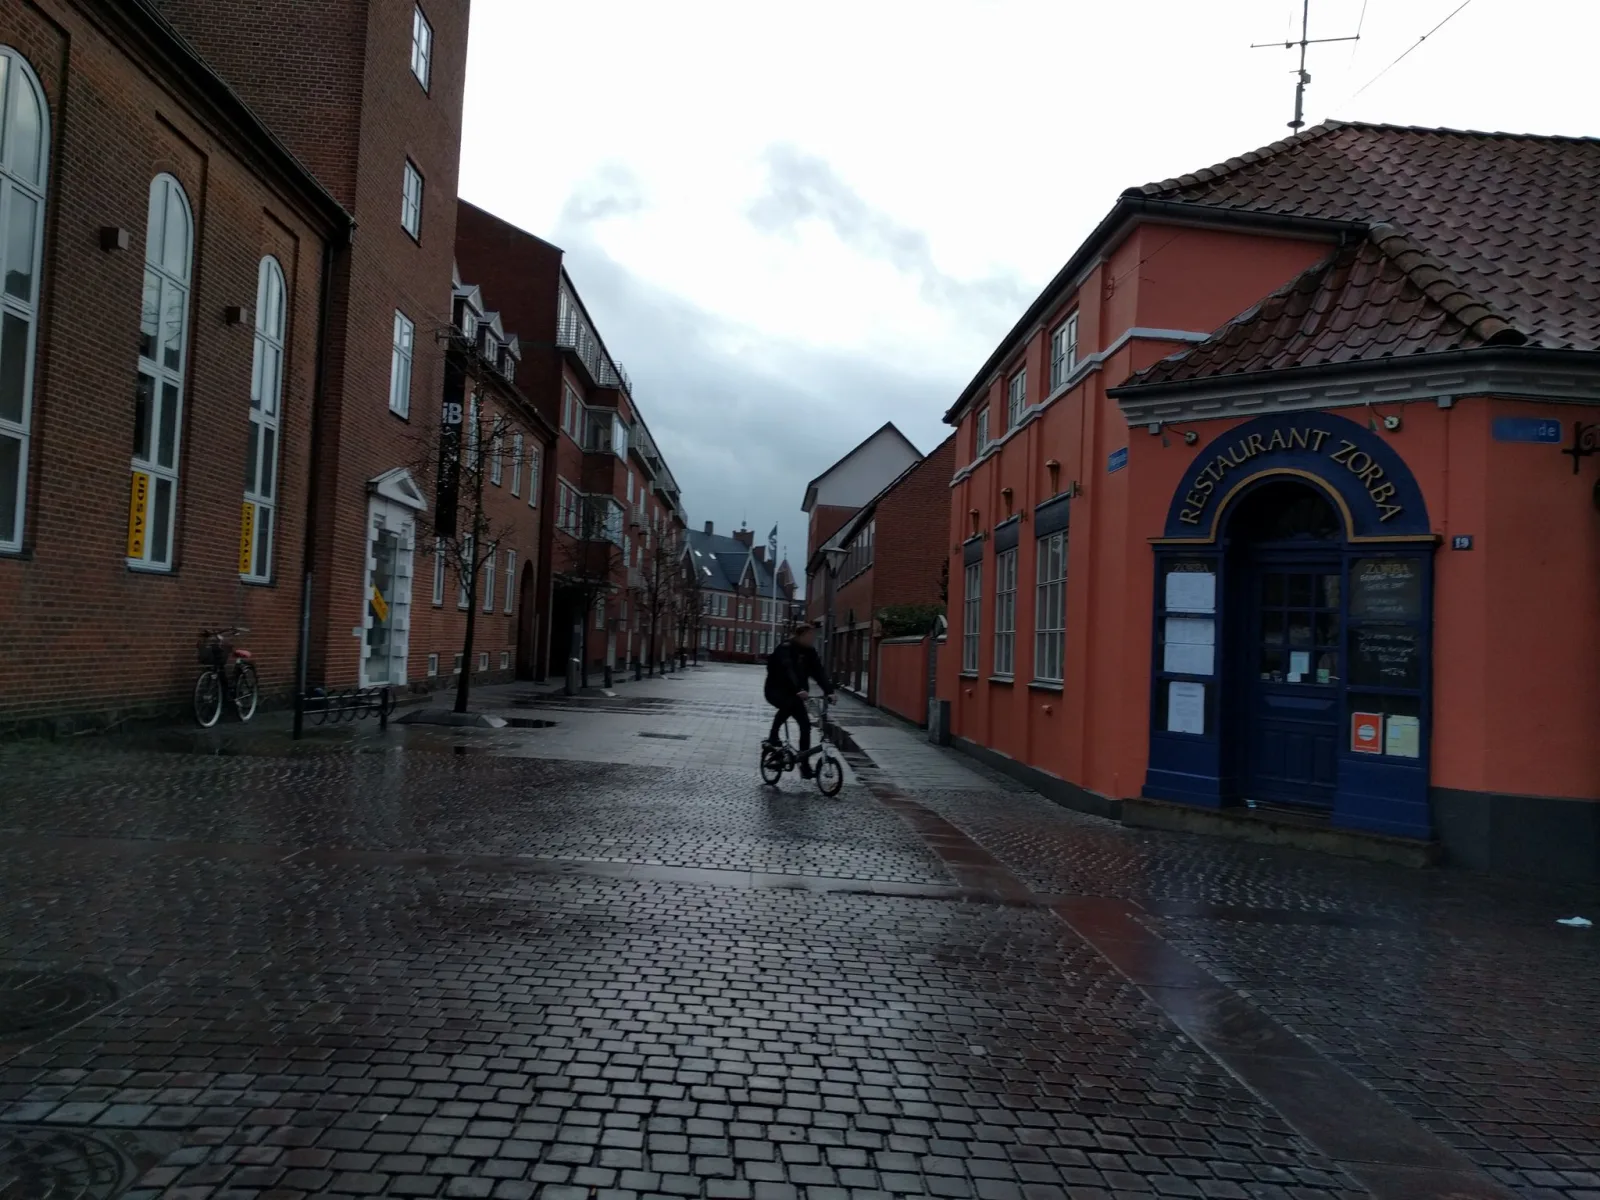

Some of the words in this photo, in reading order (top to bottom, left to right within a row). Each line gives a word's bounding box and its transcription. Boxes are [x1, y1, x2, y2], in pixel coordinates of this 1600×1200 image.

[1178, 426, 1332, 525] RESTAURANT
[1328, 438, 1404, 523] ZORBA
[1454, 537, 1470, 549] 19
